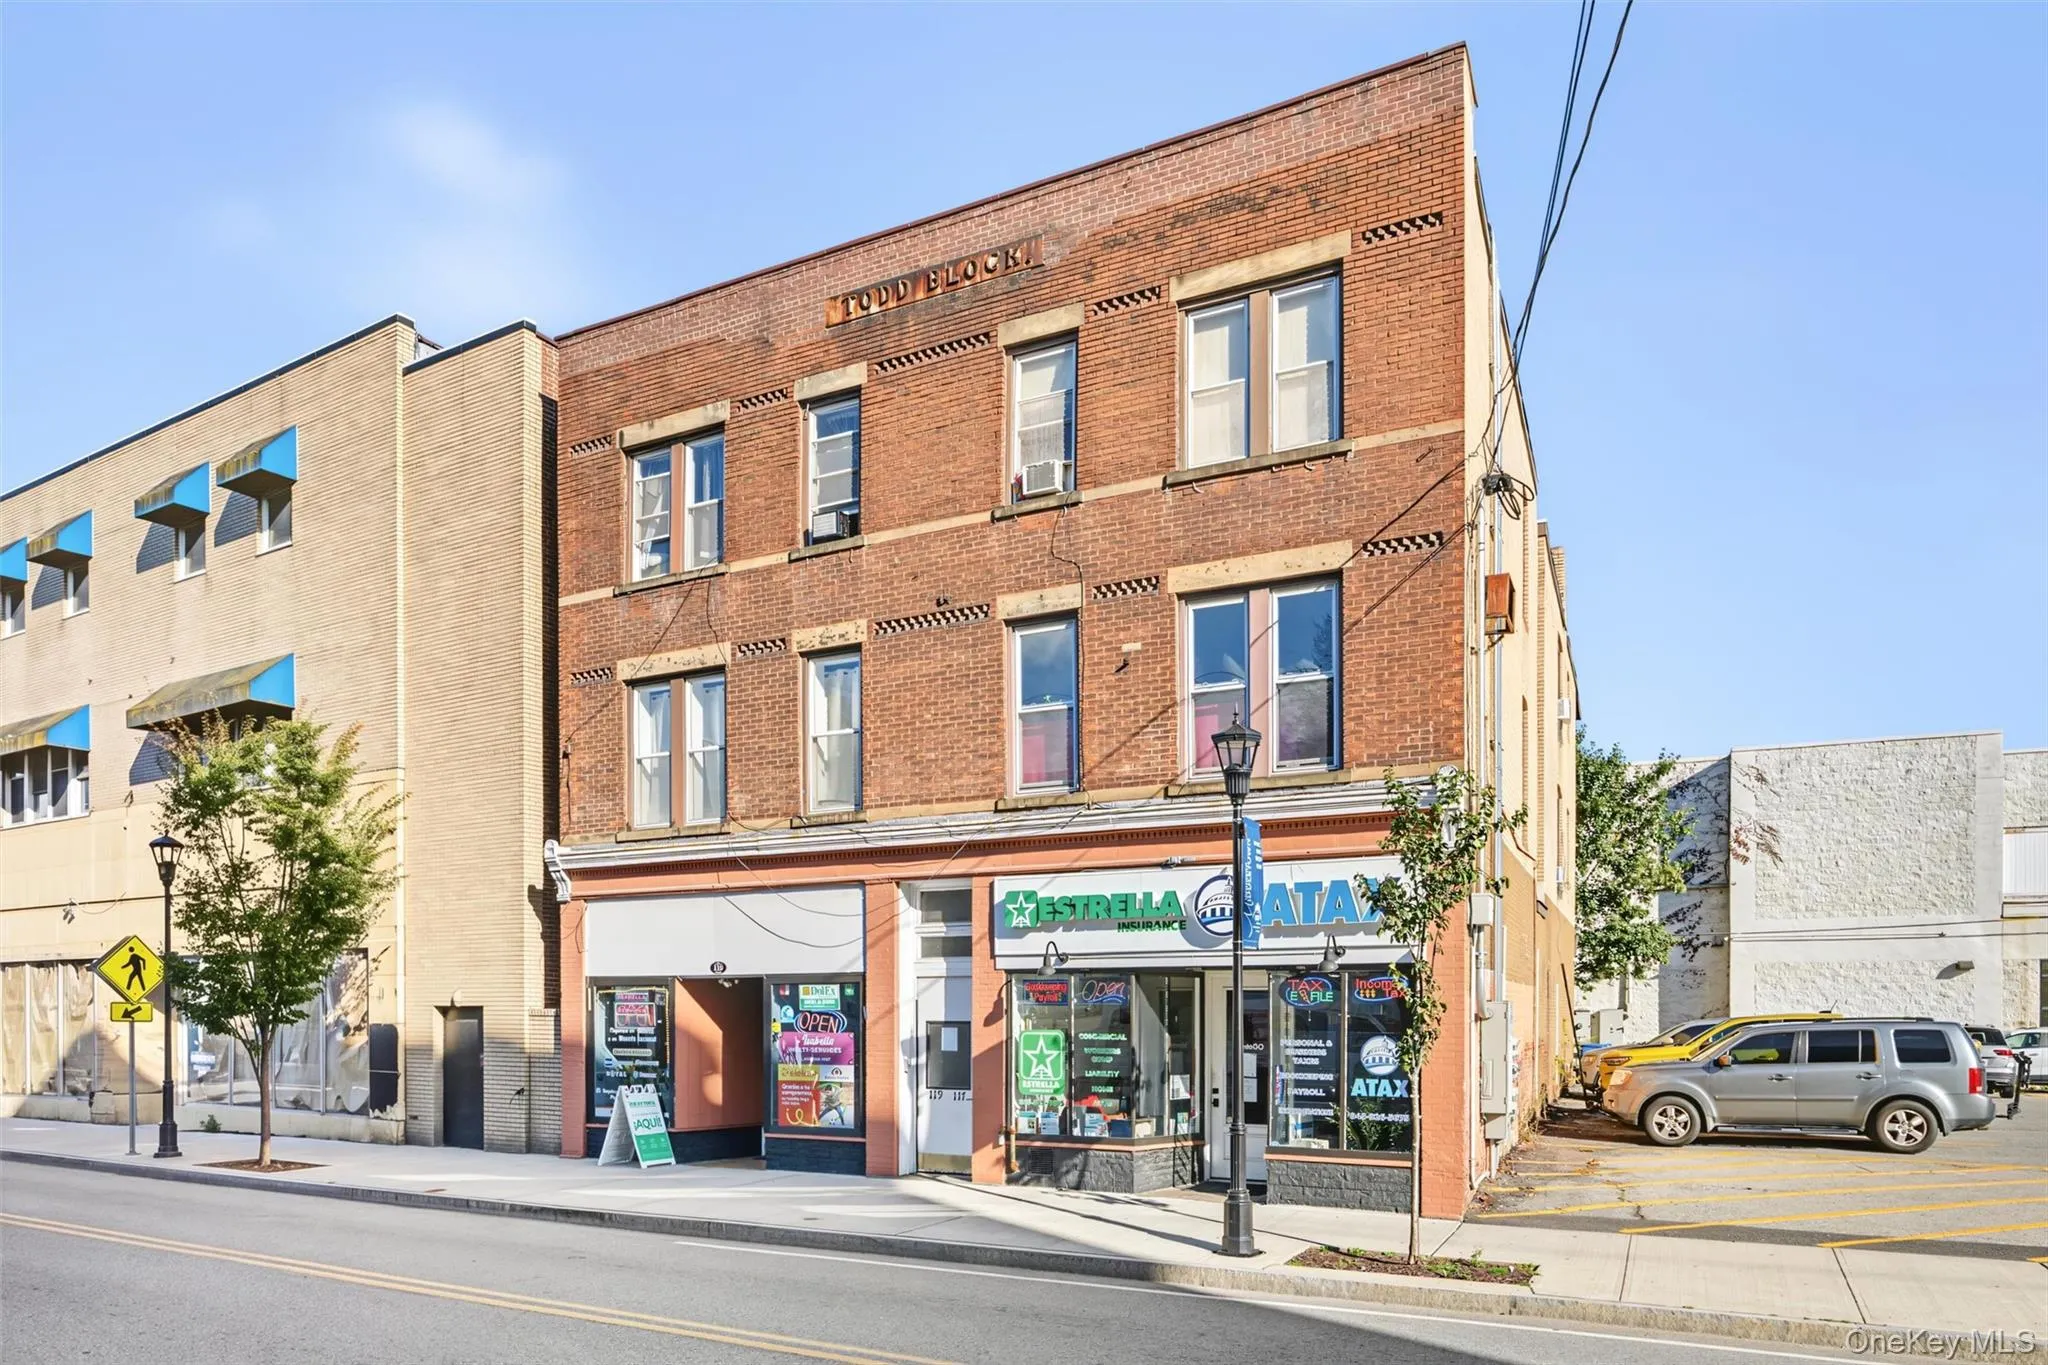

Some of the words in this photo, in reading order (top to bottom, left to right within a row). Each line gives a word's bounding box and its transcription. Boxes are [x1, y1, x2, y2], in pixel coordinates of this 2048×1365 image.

[841, 280, 909, 317] TODD
[1038, 890, 1186, 922] ESTRELLA
[1117, 919, 1187, 932] INSURANCE
[1082, 980, 1125, 1001] Open
[1288, 979, 1325, 991] TAX
[800, 1011, 839, 1034] OPEN
[929, 1090, 944, 1100] 119
[1350, 1078, 1409, 1097] ATAX
